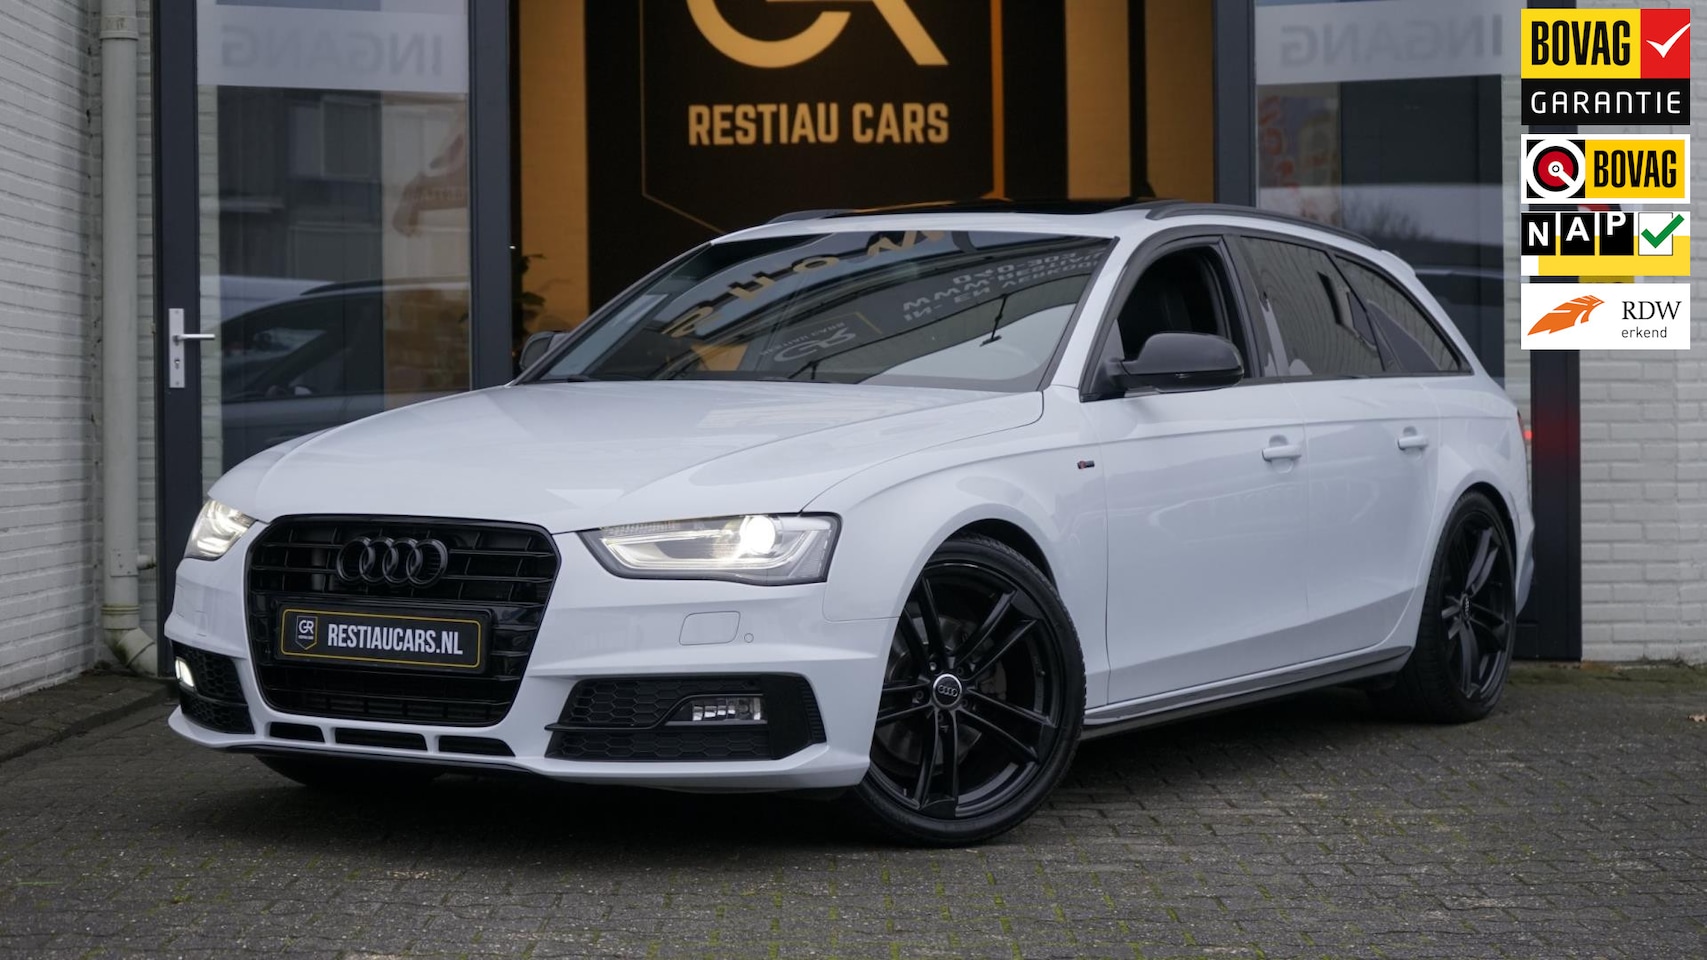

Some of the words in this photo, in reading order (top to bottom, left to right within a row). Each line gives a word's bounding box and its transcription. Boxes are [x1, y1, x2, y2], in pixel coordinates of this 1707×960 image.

[688, 103, 839, 146] RESTIAU
[853, 102, 949, 144] CARS
[327, 623, 464, 656] RESTIAUCARS.NL
